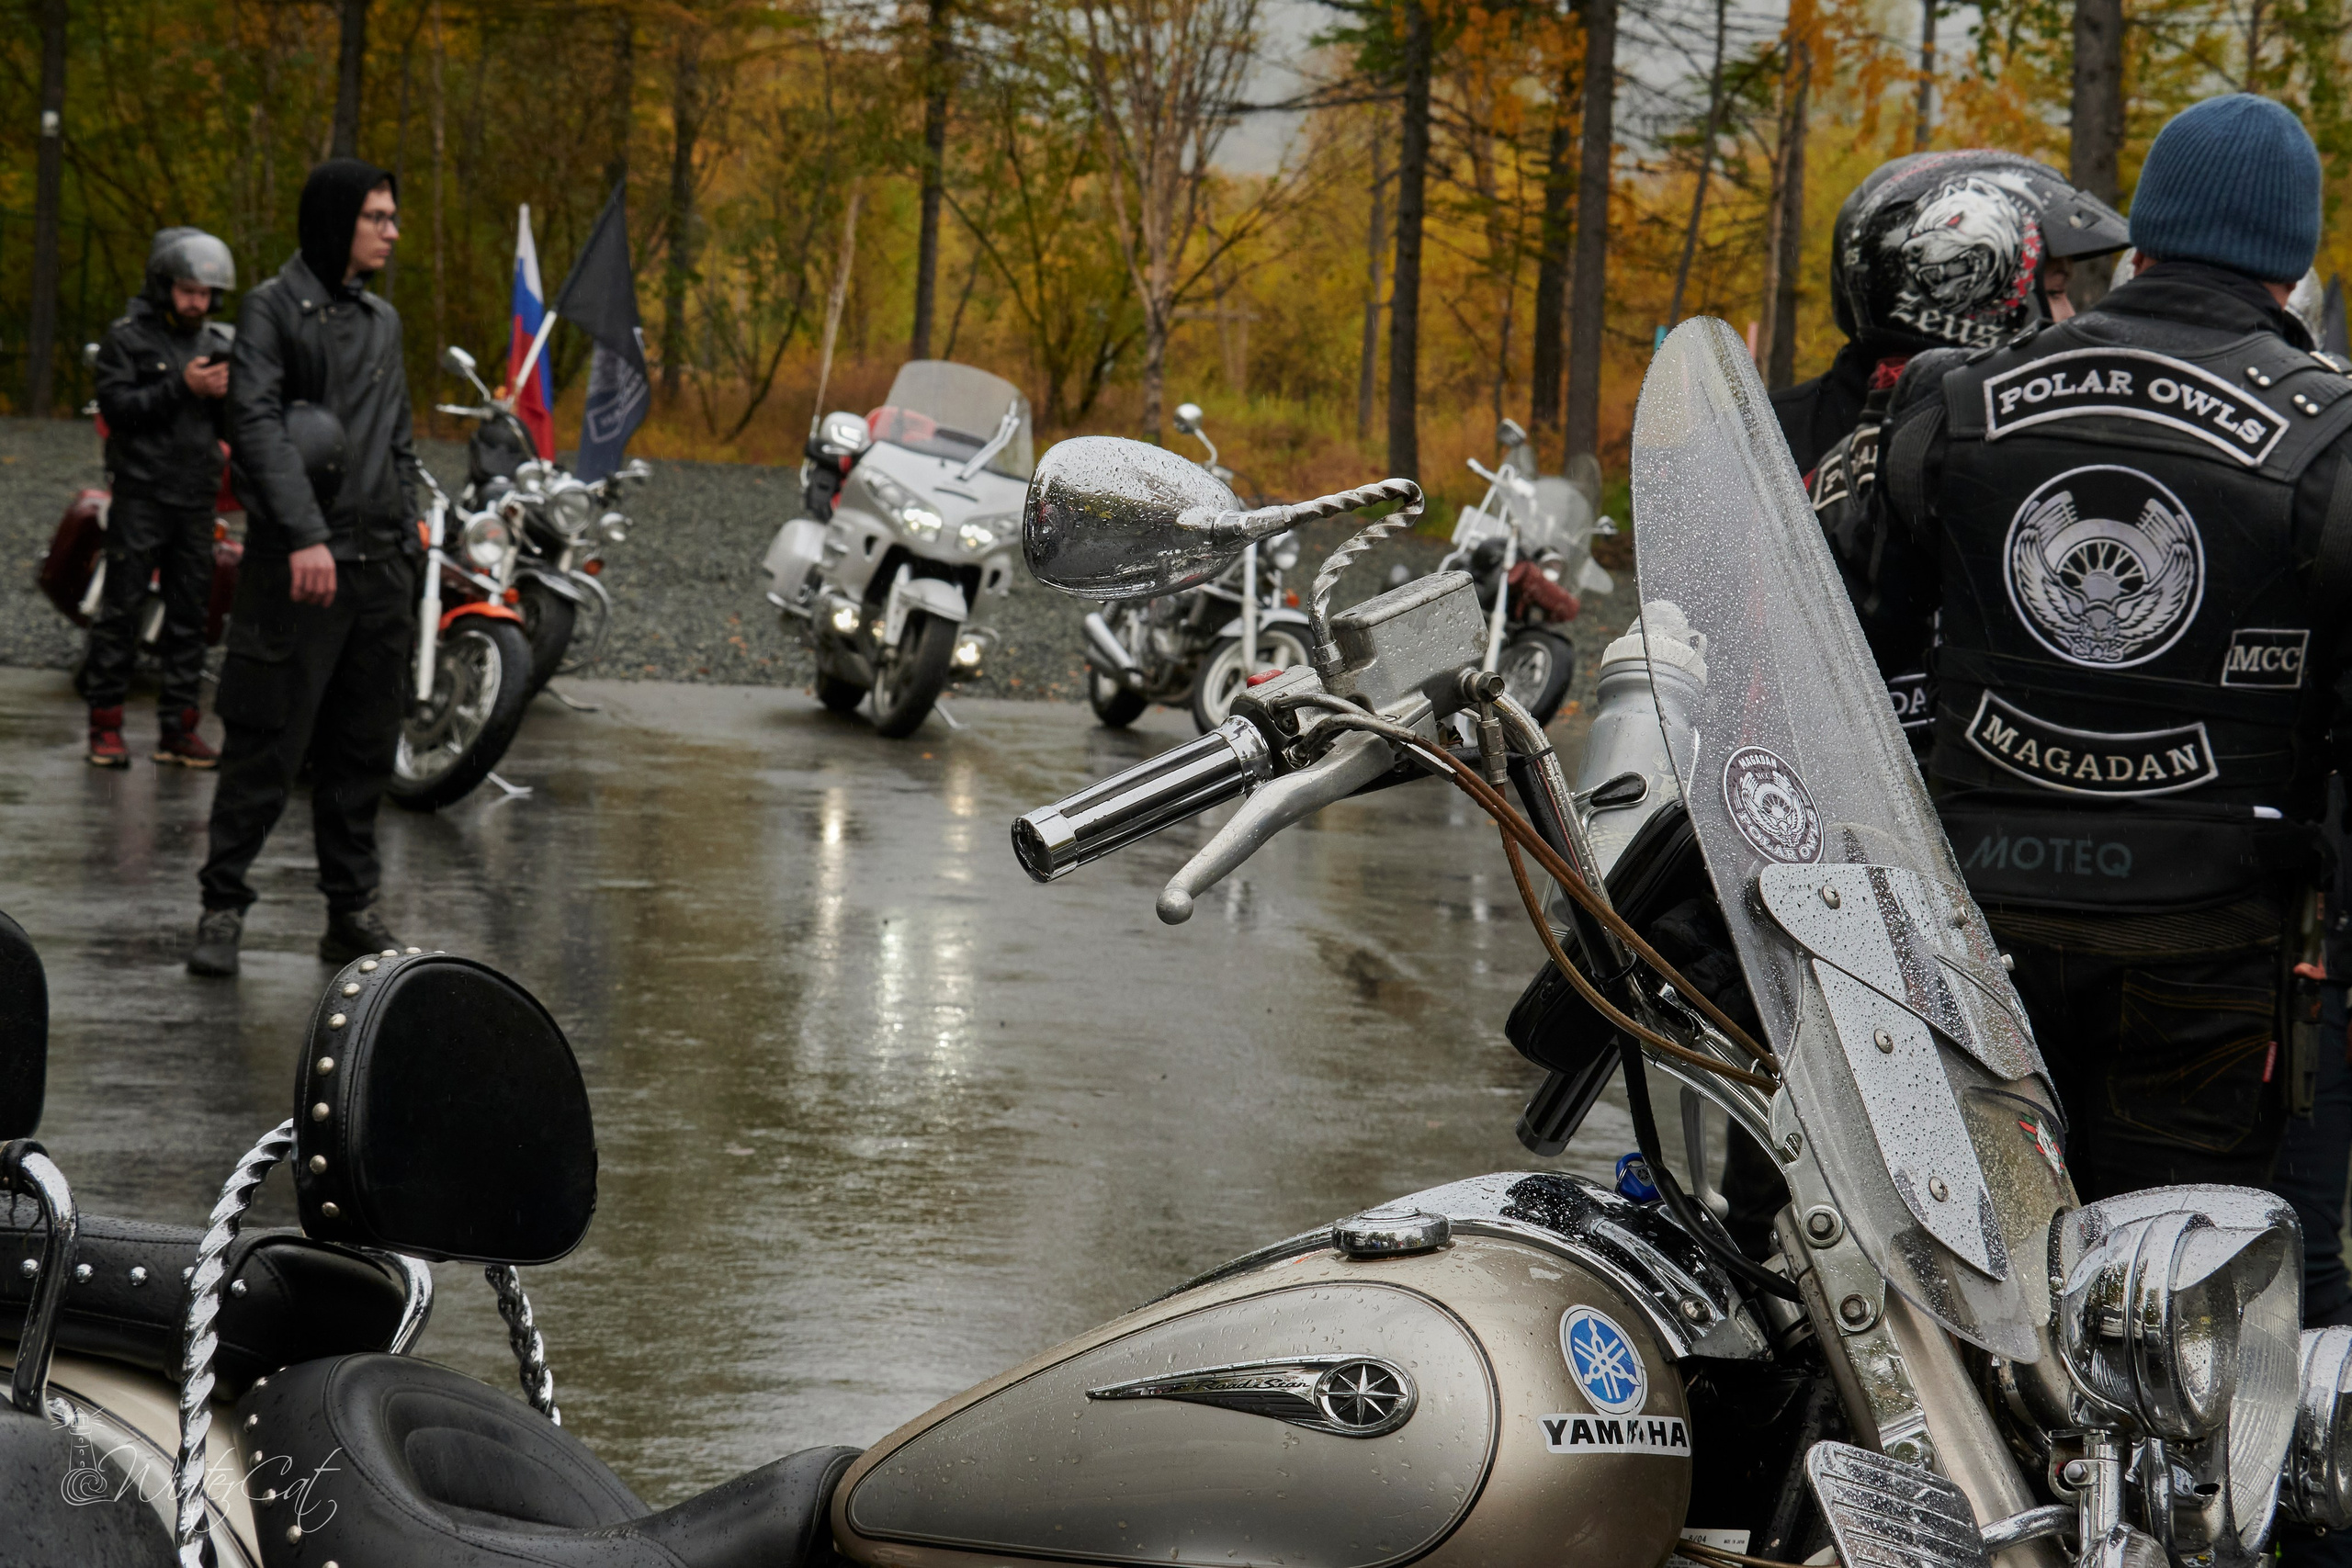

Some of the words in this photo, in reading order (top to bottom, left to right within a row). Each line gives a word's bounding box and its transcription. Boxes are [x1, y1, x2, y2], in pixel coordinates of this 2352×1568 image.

[1998, 369, 2133, 414] POLAR
[2148, 378, 2267, 445] OWLS
[2229, 645, 2301, 671] MCC
[1738, 754, 1778, 769] MAGADAN
[1982, 714, 2200, 783] MAGADAN
[1736, 811, 1799, 862] POLAR
[1798, 808, 1820, 860] OWLS
[1964, 836, 2132, 878] MOTEQ
